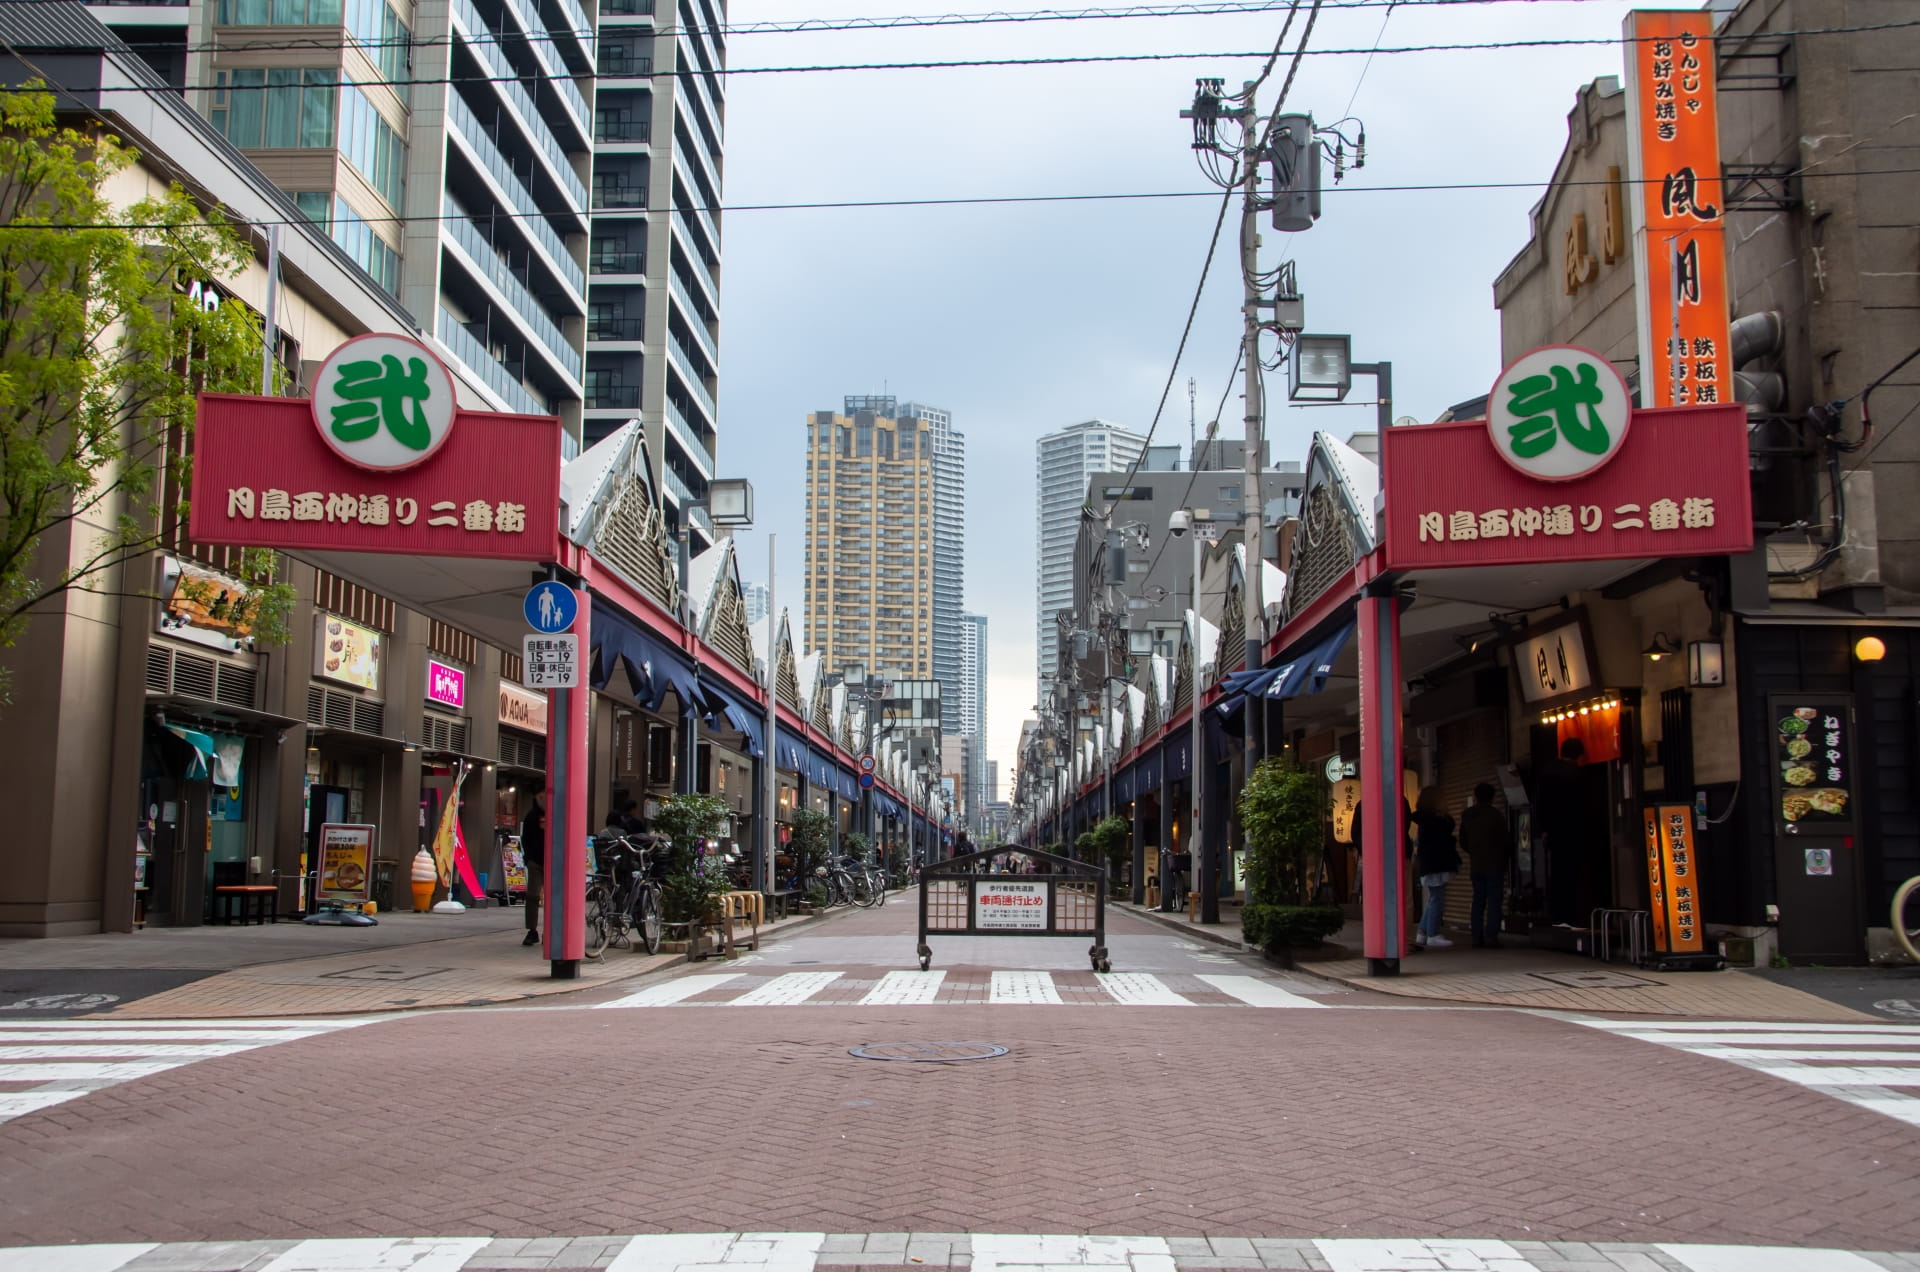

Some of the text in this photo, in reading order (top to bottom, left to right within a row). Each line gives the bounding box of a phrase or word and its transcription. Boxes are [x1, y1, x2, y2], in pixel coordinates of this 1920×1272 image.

[1653, 42, 1676, 142] お好み焼き
[1680, 31, 1701, 114] もんじゃ
[528, 640, 573, 650] 自転車を除く
[509, 699, 529, 724] AQUA
[979, 895, 1044, 906] 車両通行止め
[1669, 814, 1694, 940] お好み焼き 鉄板焼き
